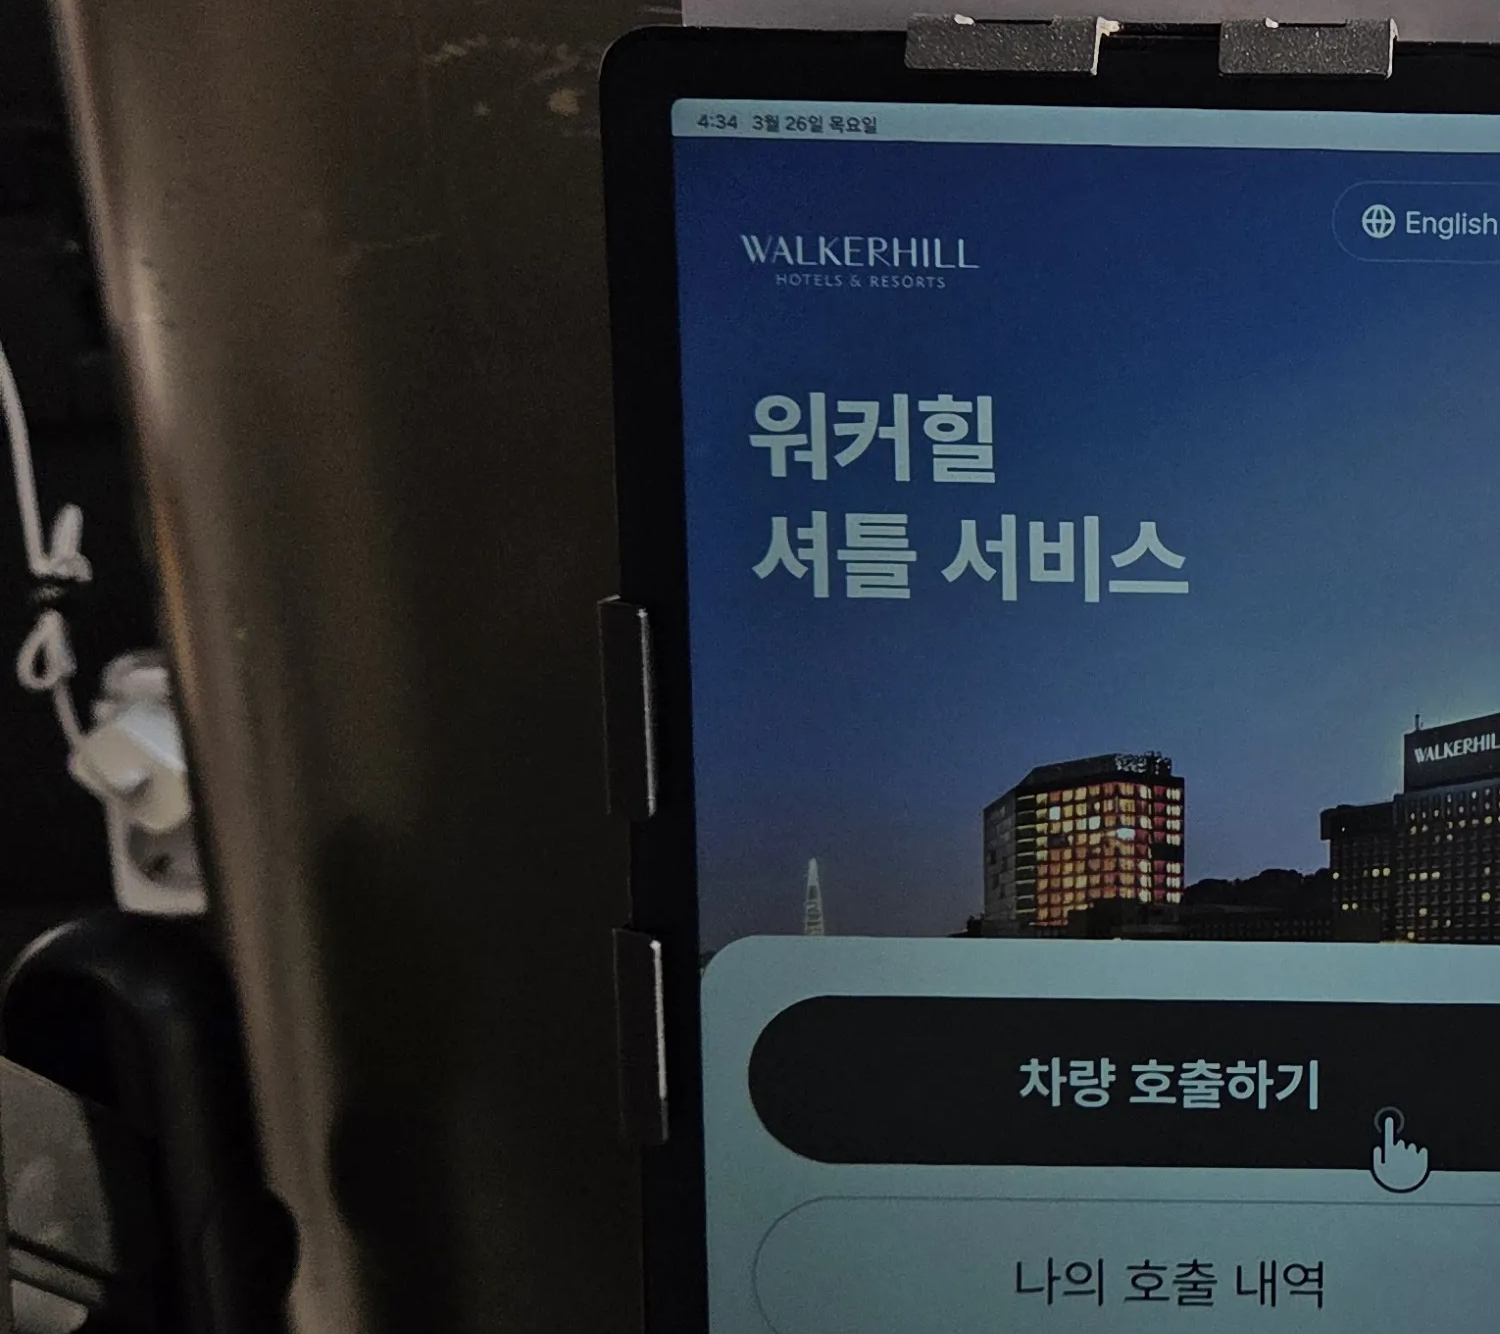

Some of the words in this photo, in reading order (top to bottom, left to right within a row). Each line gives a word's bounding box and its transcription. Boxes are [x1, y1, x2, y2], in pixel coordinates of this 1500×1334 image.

[696, 114, 738, 132] 4:34
[752, 114, 780, 133] 3월
[785, 114, 823, 134] 26일
[829, 115, 877, 135] 목요일
[1405, 211, 1498, 240] English
[741, 234, 979, 270] WALKERHILL
[776, 273, 843, 287] HOTELS
[870, 274, 946, 289] RESORTS
[749, 392, 996, 483] 워커힐
[751, 510, 917, 599] 셔틀
[941, 513, 1189, 602] 서비스
[1018, 1057, 1116, 1109] 차량
[1129, 1059, 1321, 1111] 호출하기
[1014, 1258, 1106, 1307] 나의
[1124, 1259, 1219, 1308] 호출
[1235, 1260, 1325, 1309] 내역
